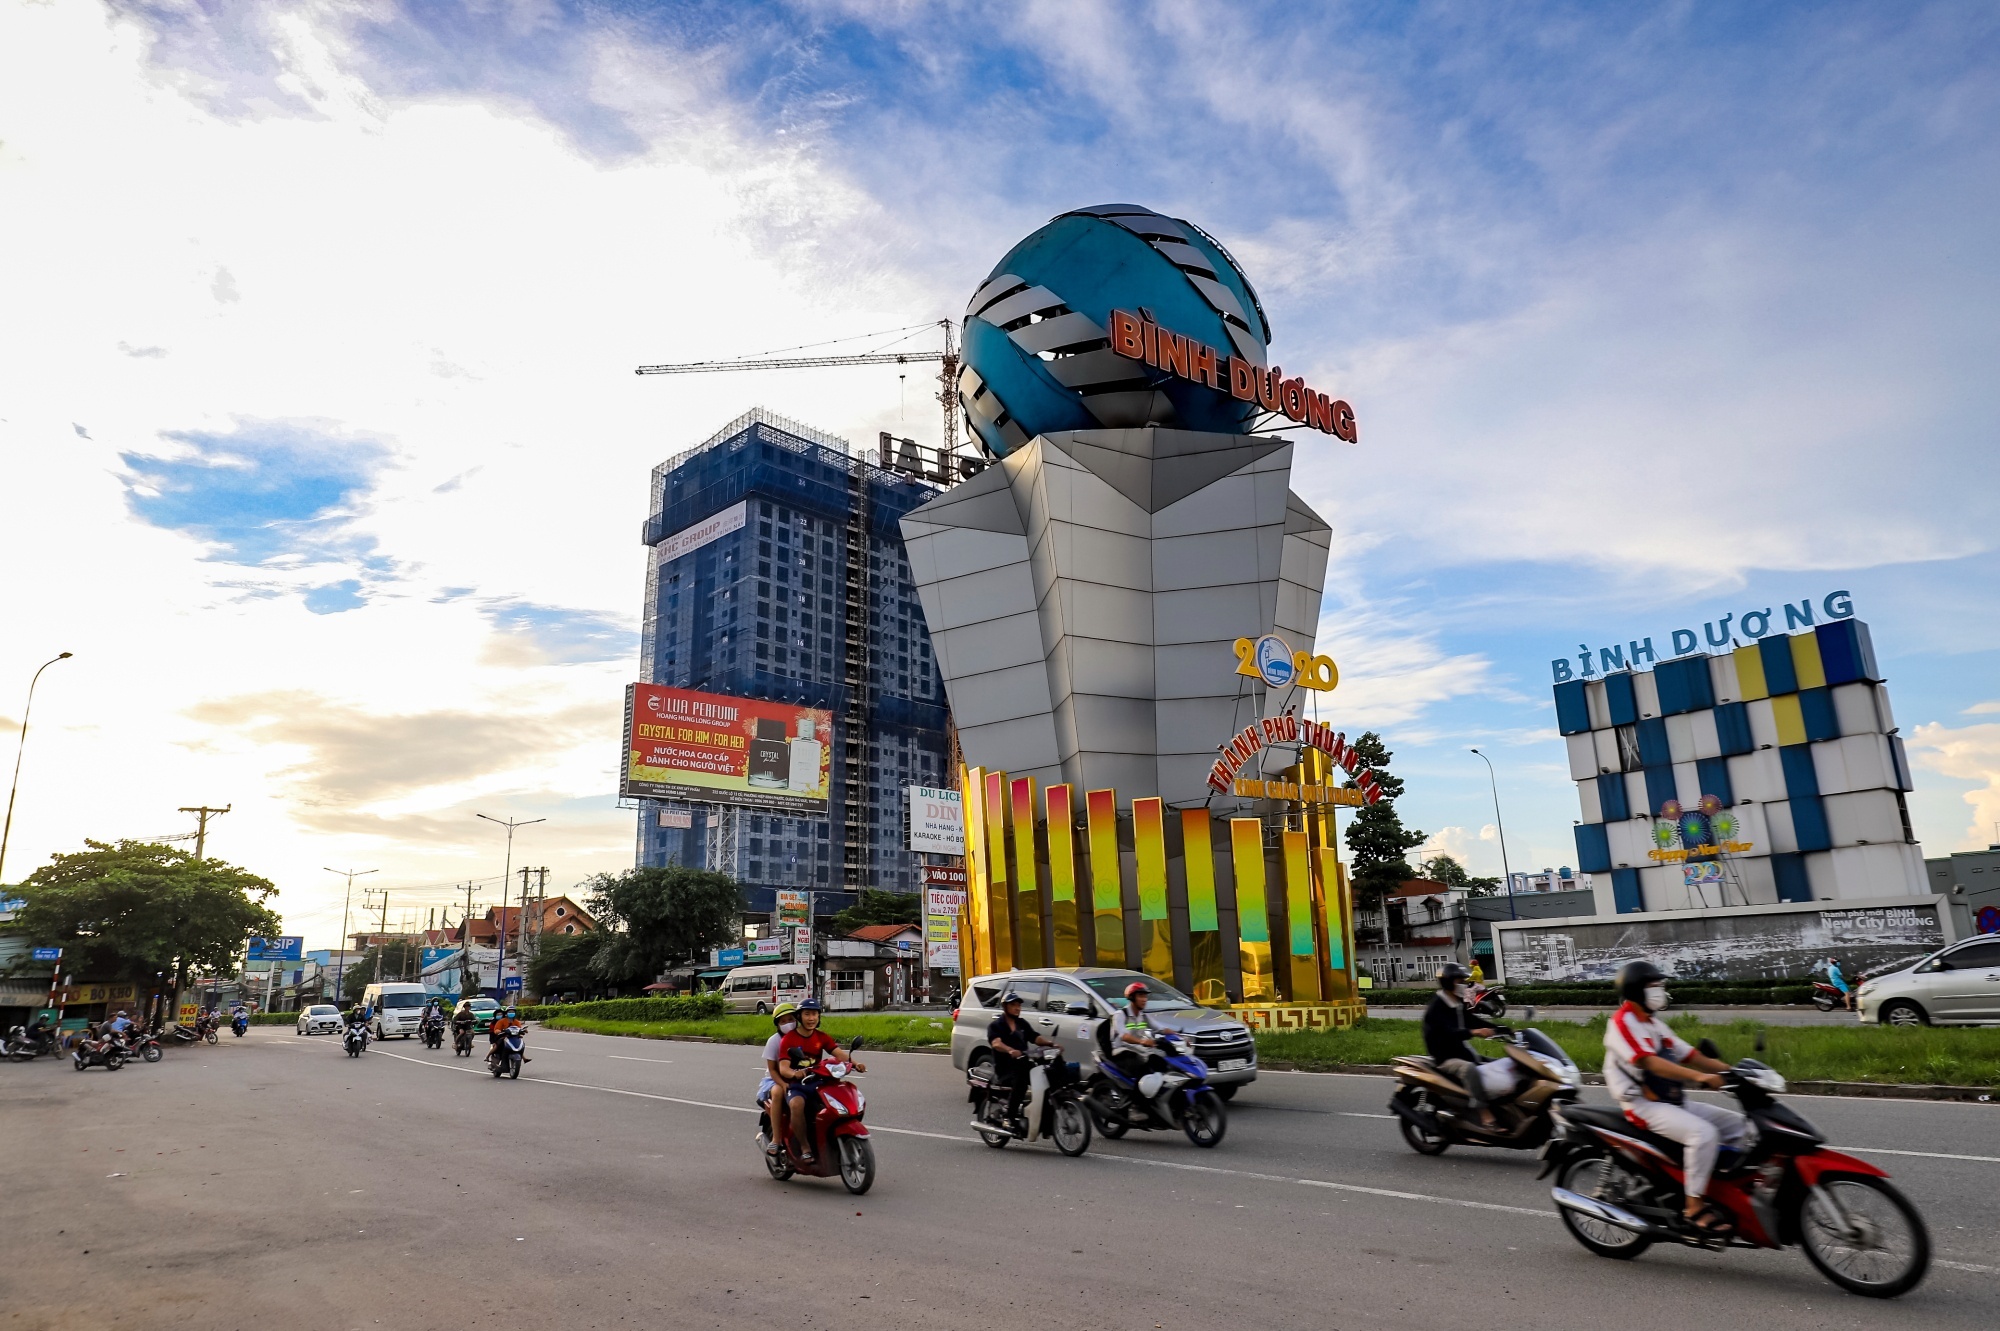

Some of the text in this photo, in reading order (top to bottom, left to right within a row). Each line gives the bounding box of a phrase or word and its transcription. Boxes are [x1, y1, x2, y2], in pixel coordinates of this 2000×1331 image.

[1111, 306, 1357, 443] BÌNH DƯƠNG
[657, 522, 720, 558] KHC GROUP
[1552, 590, 1854, 683] BÌNH DƯƠNG
[668, 698, 739, 721] LUA PERFUME
[656, 712, 677, 720] HOANG
[712, 720, 730, 728] GROUP
[638, 724, 675, 739] CRYSTAL
[678, 728, 693, 740] FOR
[730, 736, 744, 748] HER
[654, 746, 729, 762] NƯỚC HOA CAO CẤP
[760, 750, 779, 760] CRYSTAL
[1206, 705, 1383, 806] THÀNH PHỐ THUẬN AN
[646, 755, 734, 774] DÀNH CHO NGƯỜI VIỆT
[920, 788, 935, 798] DU
[1266, 776, 1299, 800] CHÀO
[926, 801, 958, 821] DÌN
[926, 821, 938, 829] NHÀ
[938, 822, 954, 831] HÀNG
[914, 832, 941, 840] KARAOKE
[1648, 840, 1754, 862] Happy New Year
[932, 869, 946, 880] VÀO
[930, 892, 944, 906] TIỆC
[1847, 909, 1865, 919] phố
[1886, 908, 1916, 918] BÌNH
[1821, 916, 1934, 930] New City DƯƠNG
